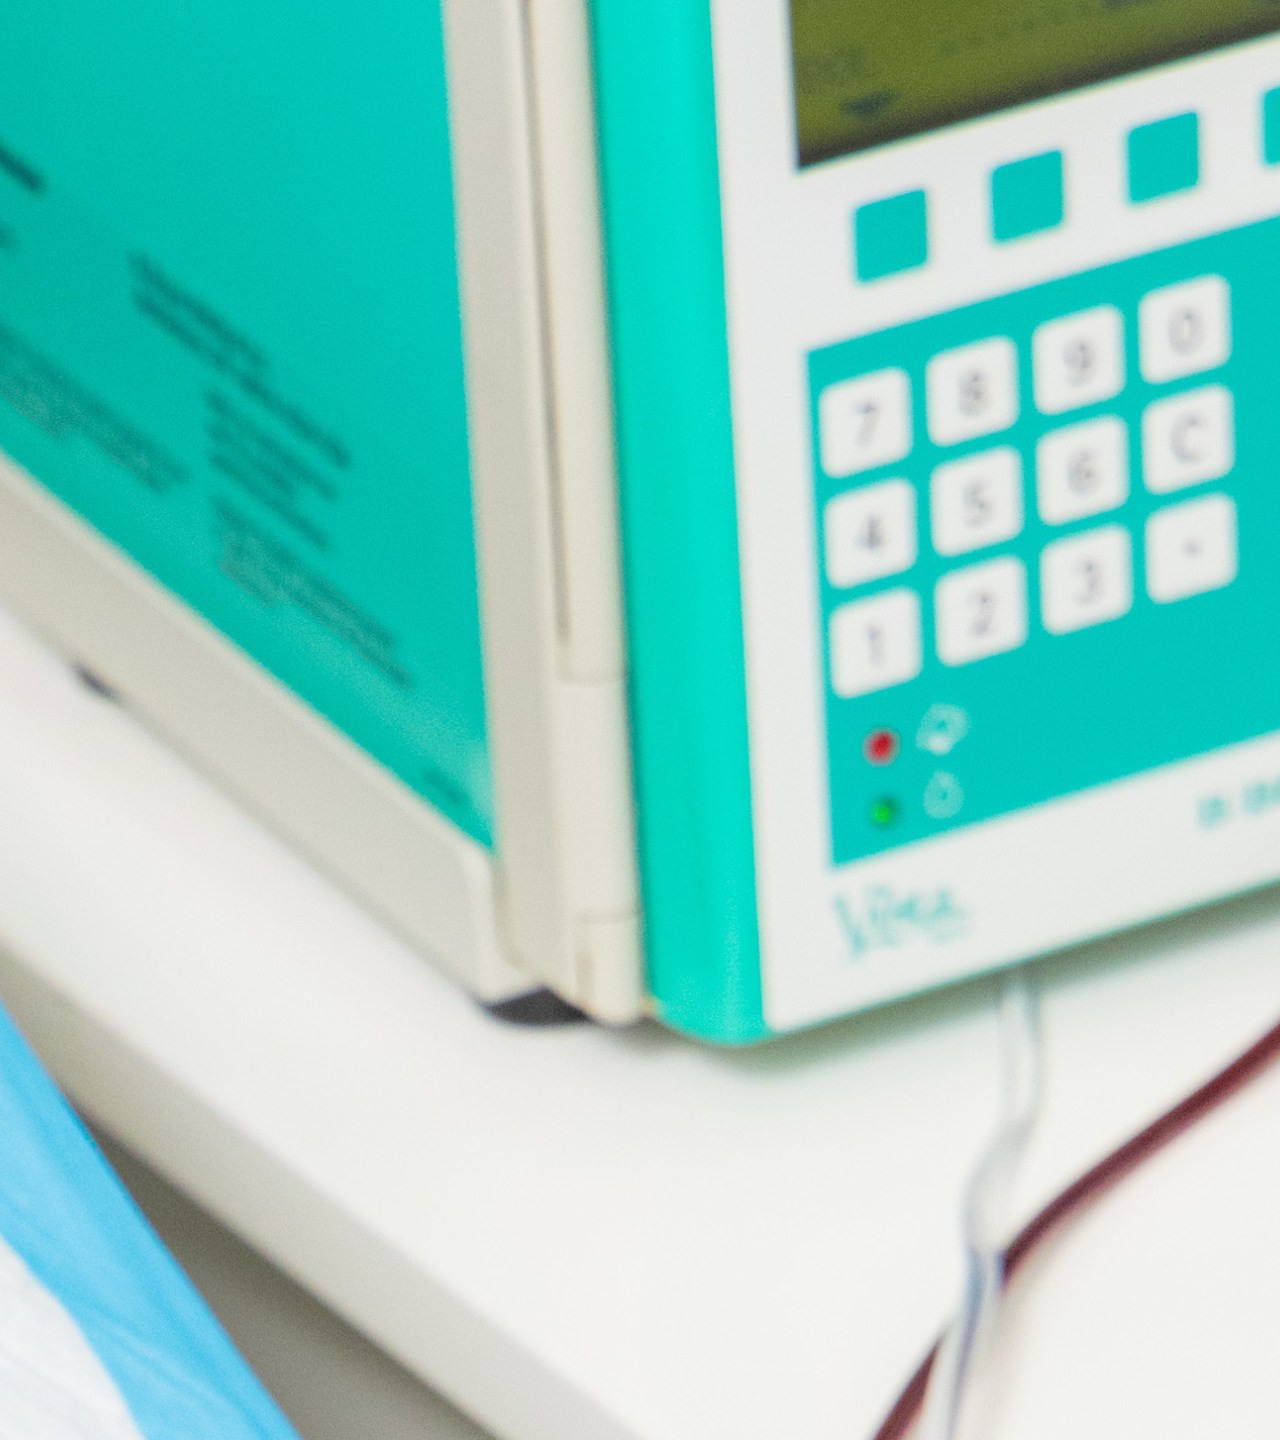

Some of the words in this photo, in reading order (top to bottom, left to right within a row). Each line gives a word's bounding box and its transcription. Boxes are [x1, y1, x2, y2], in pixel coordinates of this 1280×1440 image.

[853, 400, 878, 451] 7
[957, 369, 991, 418] 8
[1063, 336, 1098, 387] 9
[857, 512, 885, 553] 4
[960, 480, 993, 529] 5
[1067, 447, 1101, 498] 6
[1169, 413, 1204, 467] C
[970, 589, 995, 638] 2
[1075, 559, 1104, 608] 3
